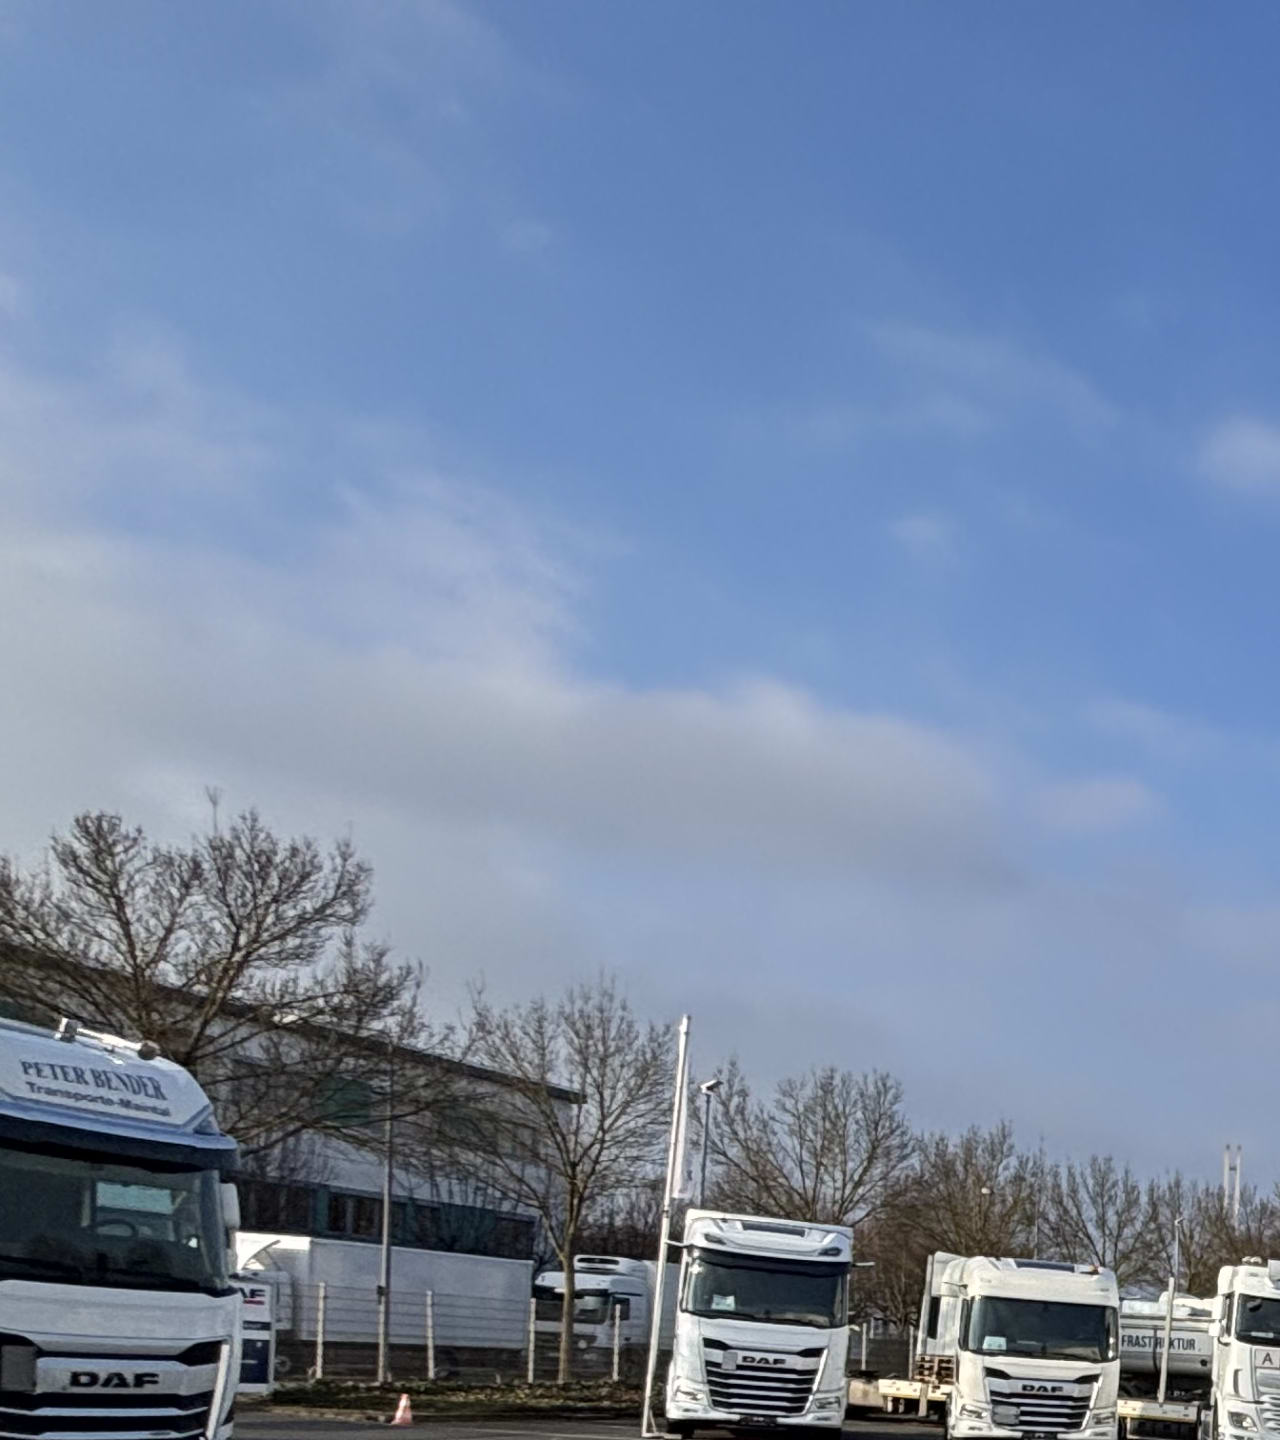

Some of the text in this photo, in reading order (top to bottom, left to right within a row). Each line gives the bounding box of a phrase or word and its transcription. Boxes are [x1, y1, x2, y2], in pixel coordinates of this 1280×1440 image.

[20, 1060, 168, 1101] PETER BENDER
[741, 1356, 786, 1365] DAF
[1262, 1352, 1273, 1365] A
[70, 1371, 159, 1388] DAF
[1021, 1384, 1063, 1393] DAF
